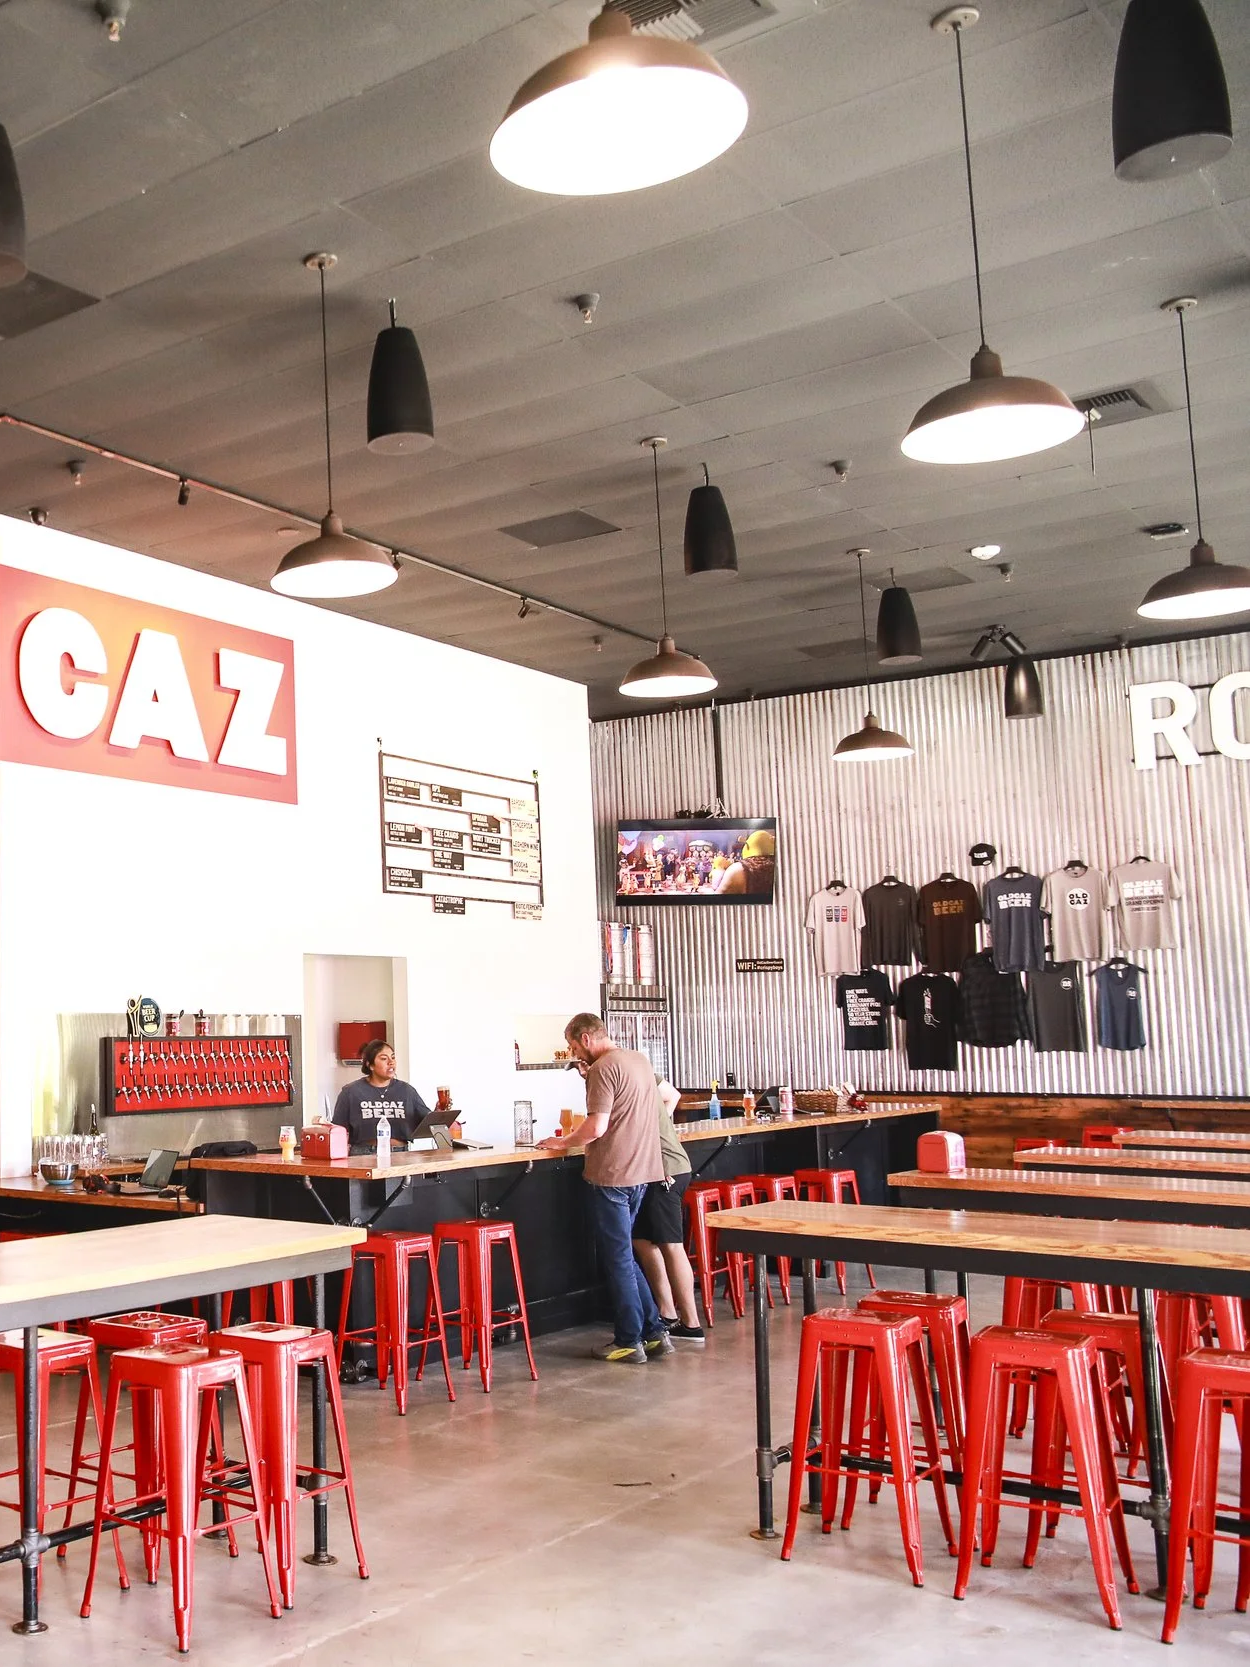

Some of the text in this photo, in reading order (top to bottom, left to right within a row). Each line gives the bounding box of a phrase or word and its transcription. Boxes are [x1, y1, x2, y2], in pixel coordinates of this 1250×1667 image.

[18, 606, 288, 777] CAZ
[433, 828, 444, 837] FREE
[435, 895, 464, 905] CATASTROPHE
[998, 899, 1031, 909] BEER
[934, 905, 964, 915] BEER
[737, 962, 757, 970] WIFI:
[360, 1100, 405, 1109] OLDCAZ
[361, 1108, 406, 1119] BEER
